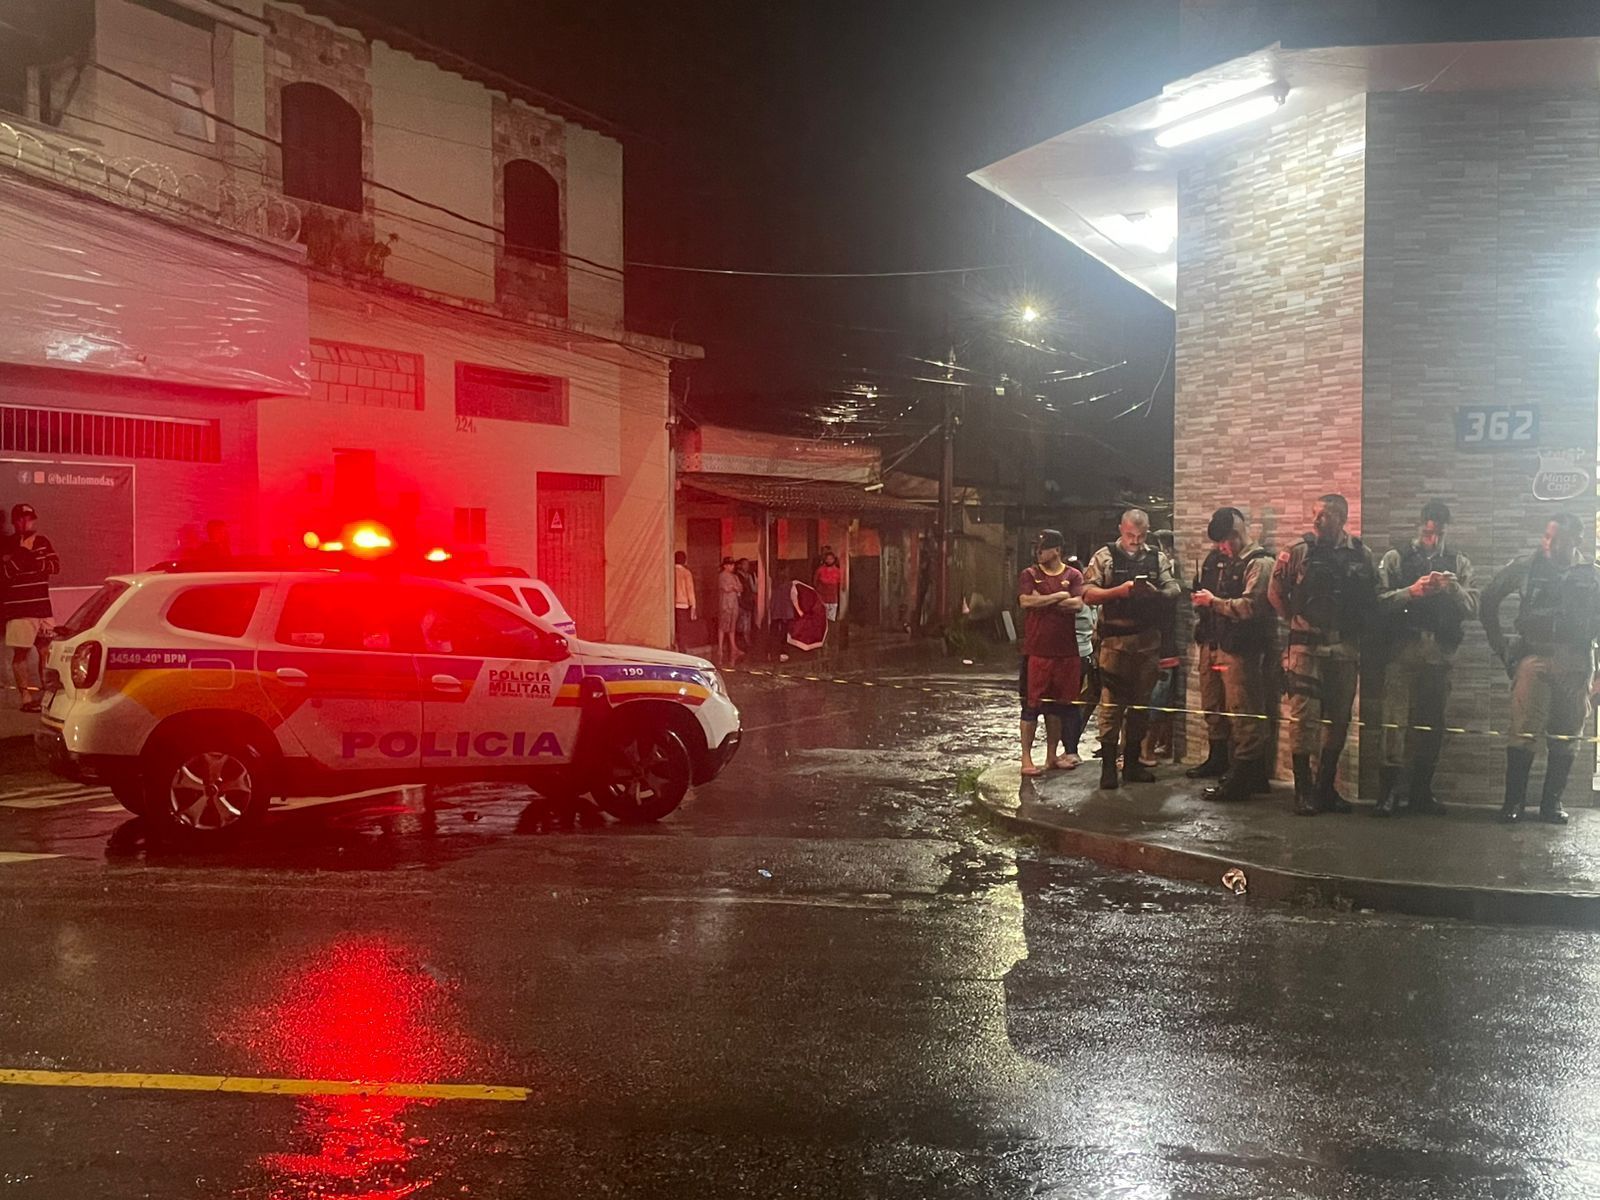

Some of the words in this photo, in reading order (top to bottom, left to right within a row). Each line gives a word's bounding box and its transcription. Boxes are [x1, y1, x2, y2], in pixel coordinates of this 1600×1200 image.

[1464, 410, 1533, 442] 362
[163, 654, 187, 664] BPM
[622, 667, 644, 676] 190
[489, 682, 551, 694] MILITAR
[341, 731, 564, 759] POLICIA
